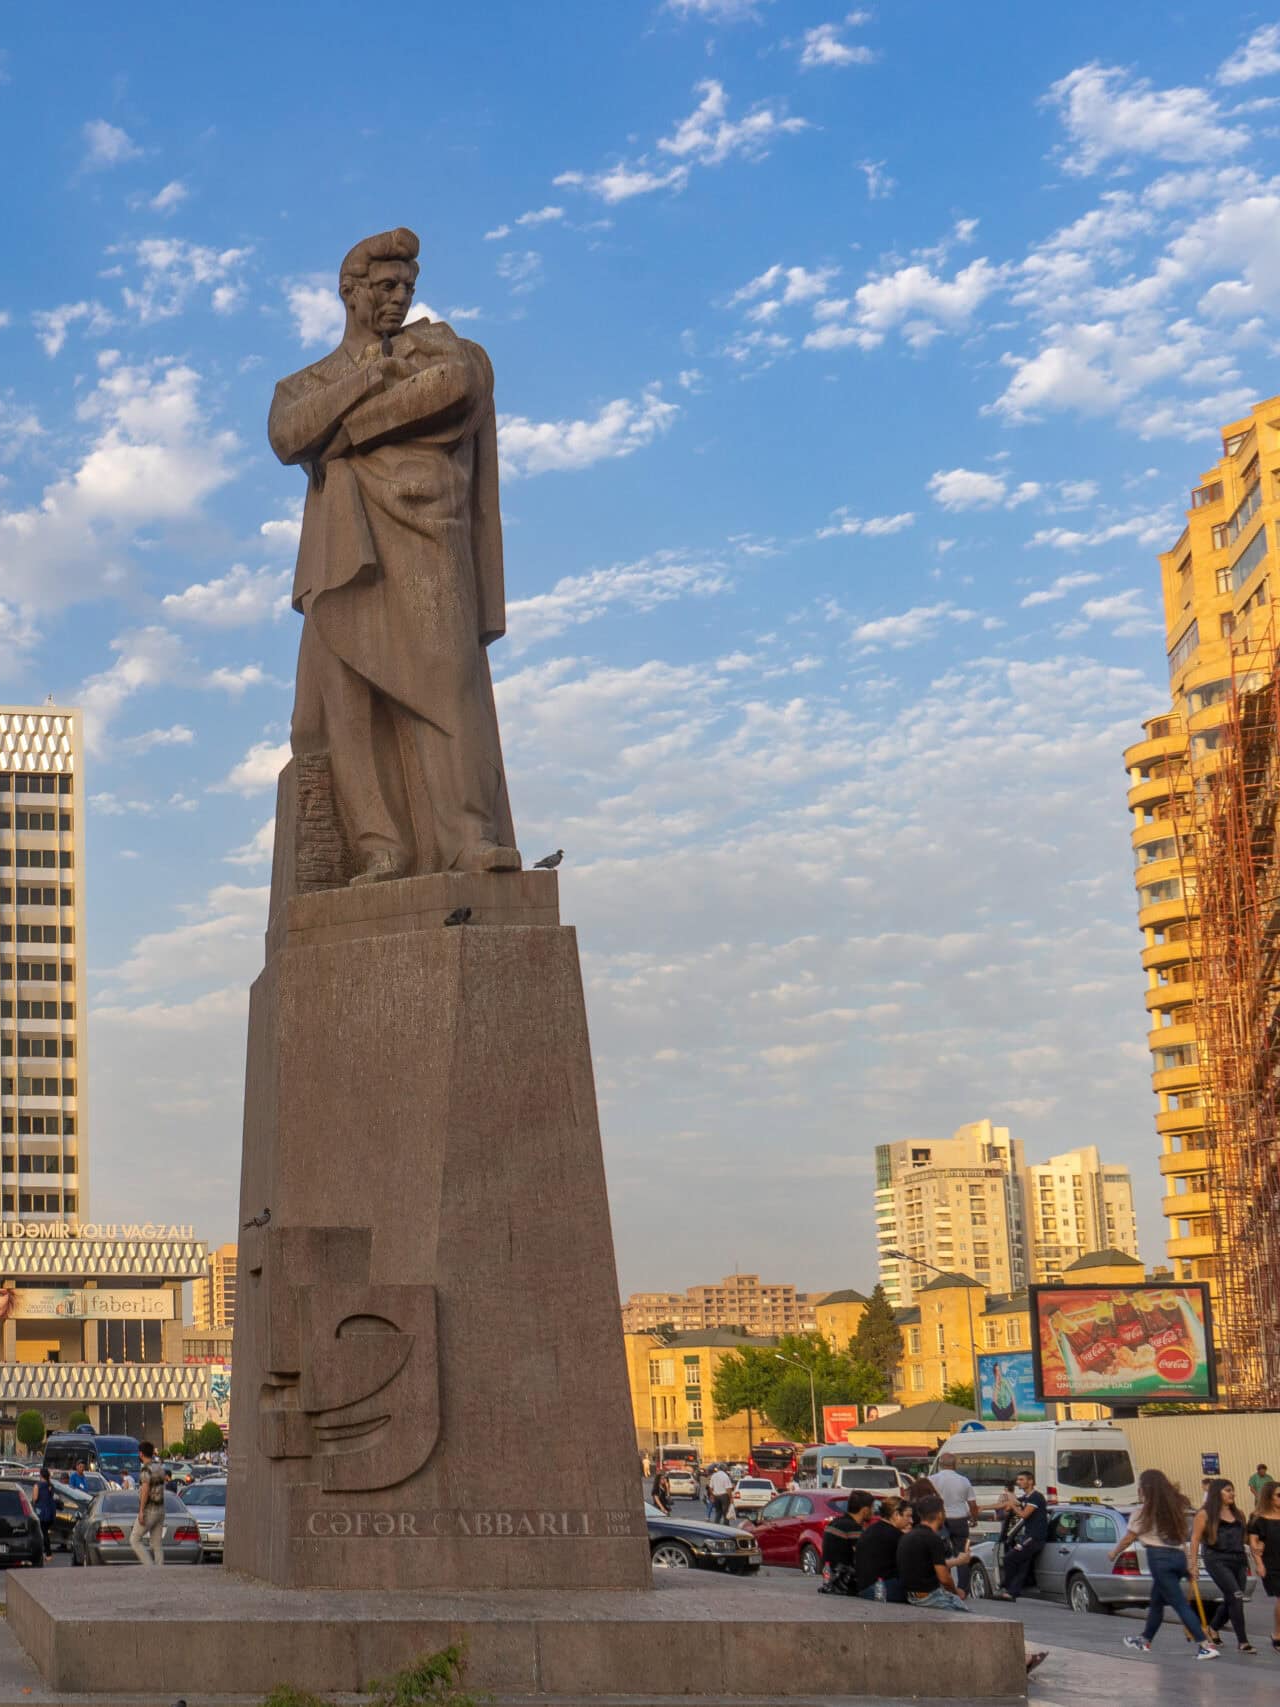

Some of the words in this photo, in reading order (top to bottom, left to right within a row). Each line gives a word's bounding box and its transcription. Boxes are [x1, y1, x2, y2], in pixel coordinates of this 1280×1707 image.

[12, 1220, 70, 1238] DƏMİR
[74, 1223, 116, 1239] YOLU
[121, 1221, 193, 1239] VAĞZALI
[90, 1295, 164, 1313] faberlic
[307, 1511, 419, 1535] CƏFƏR
